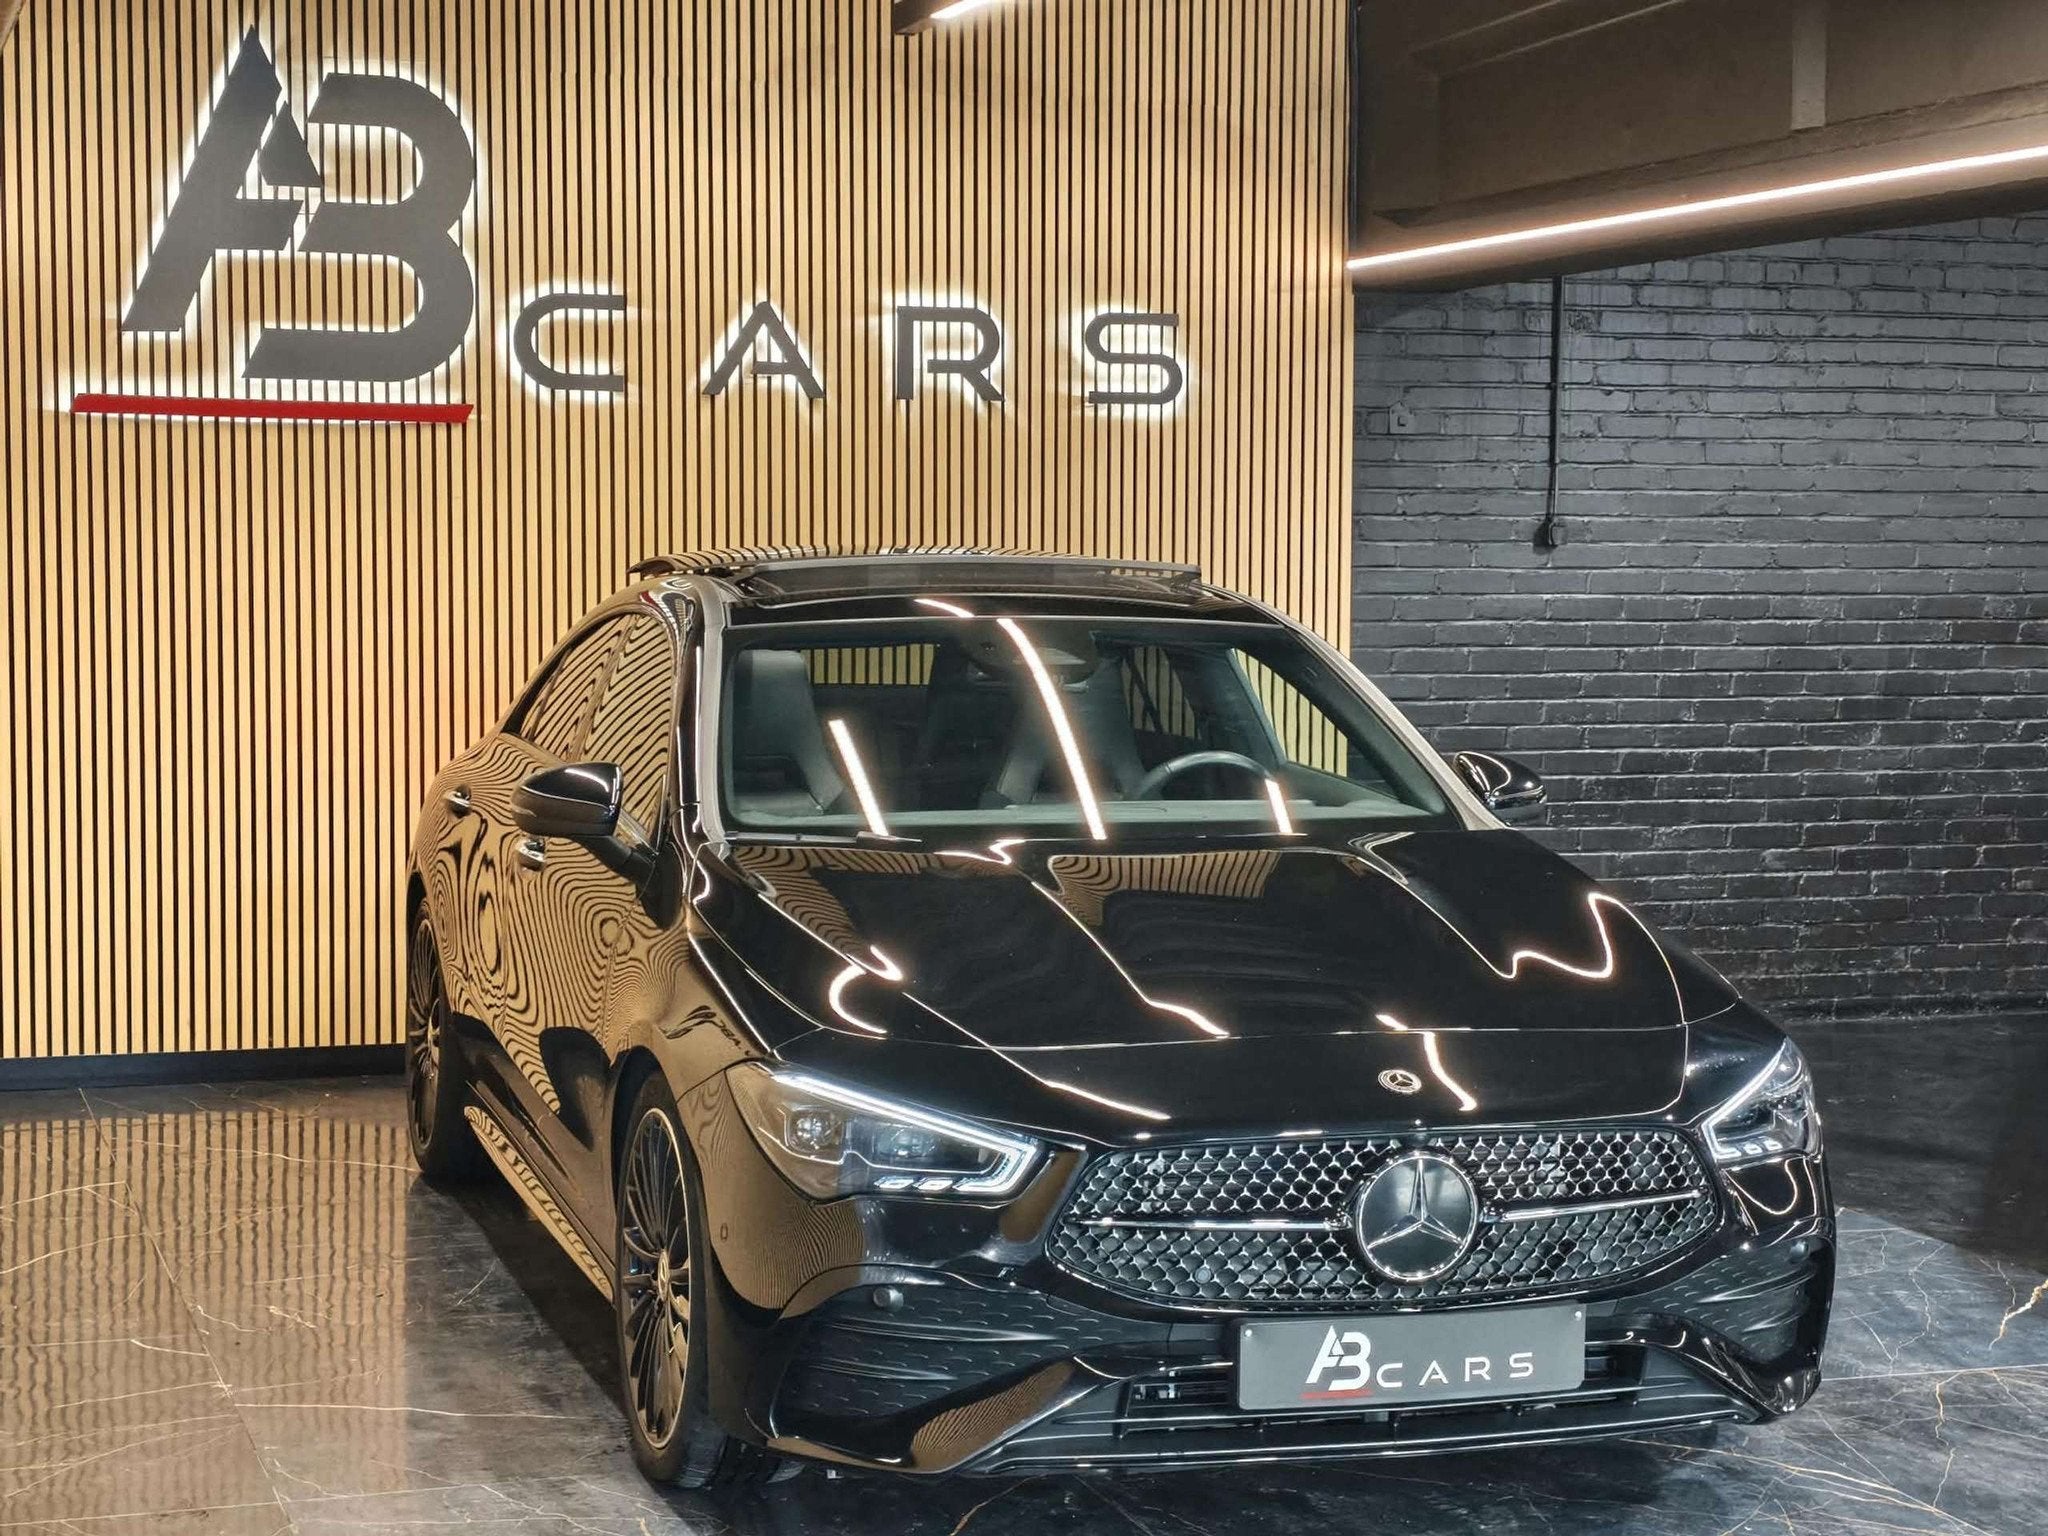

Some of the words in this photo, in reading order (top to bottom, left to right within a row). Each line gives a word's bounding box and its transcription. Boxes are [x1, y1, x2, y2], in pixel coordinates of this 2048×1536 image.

[121, 24, 474, 382] AB
[514, 292, 1183, 404] CARS
[1305, 1325, 1371, 1391] AB
[1375, 1352, 1534, 1388] CARS
